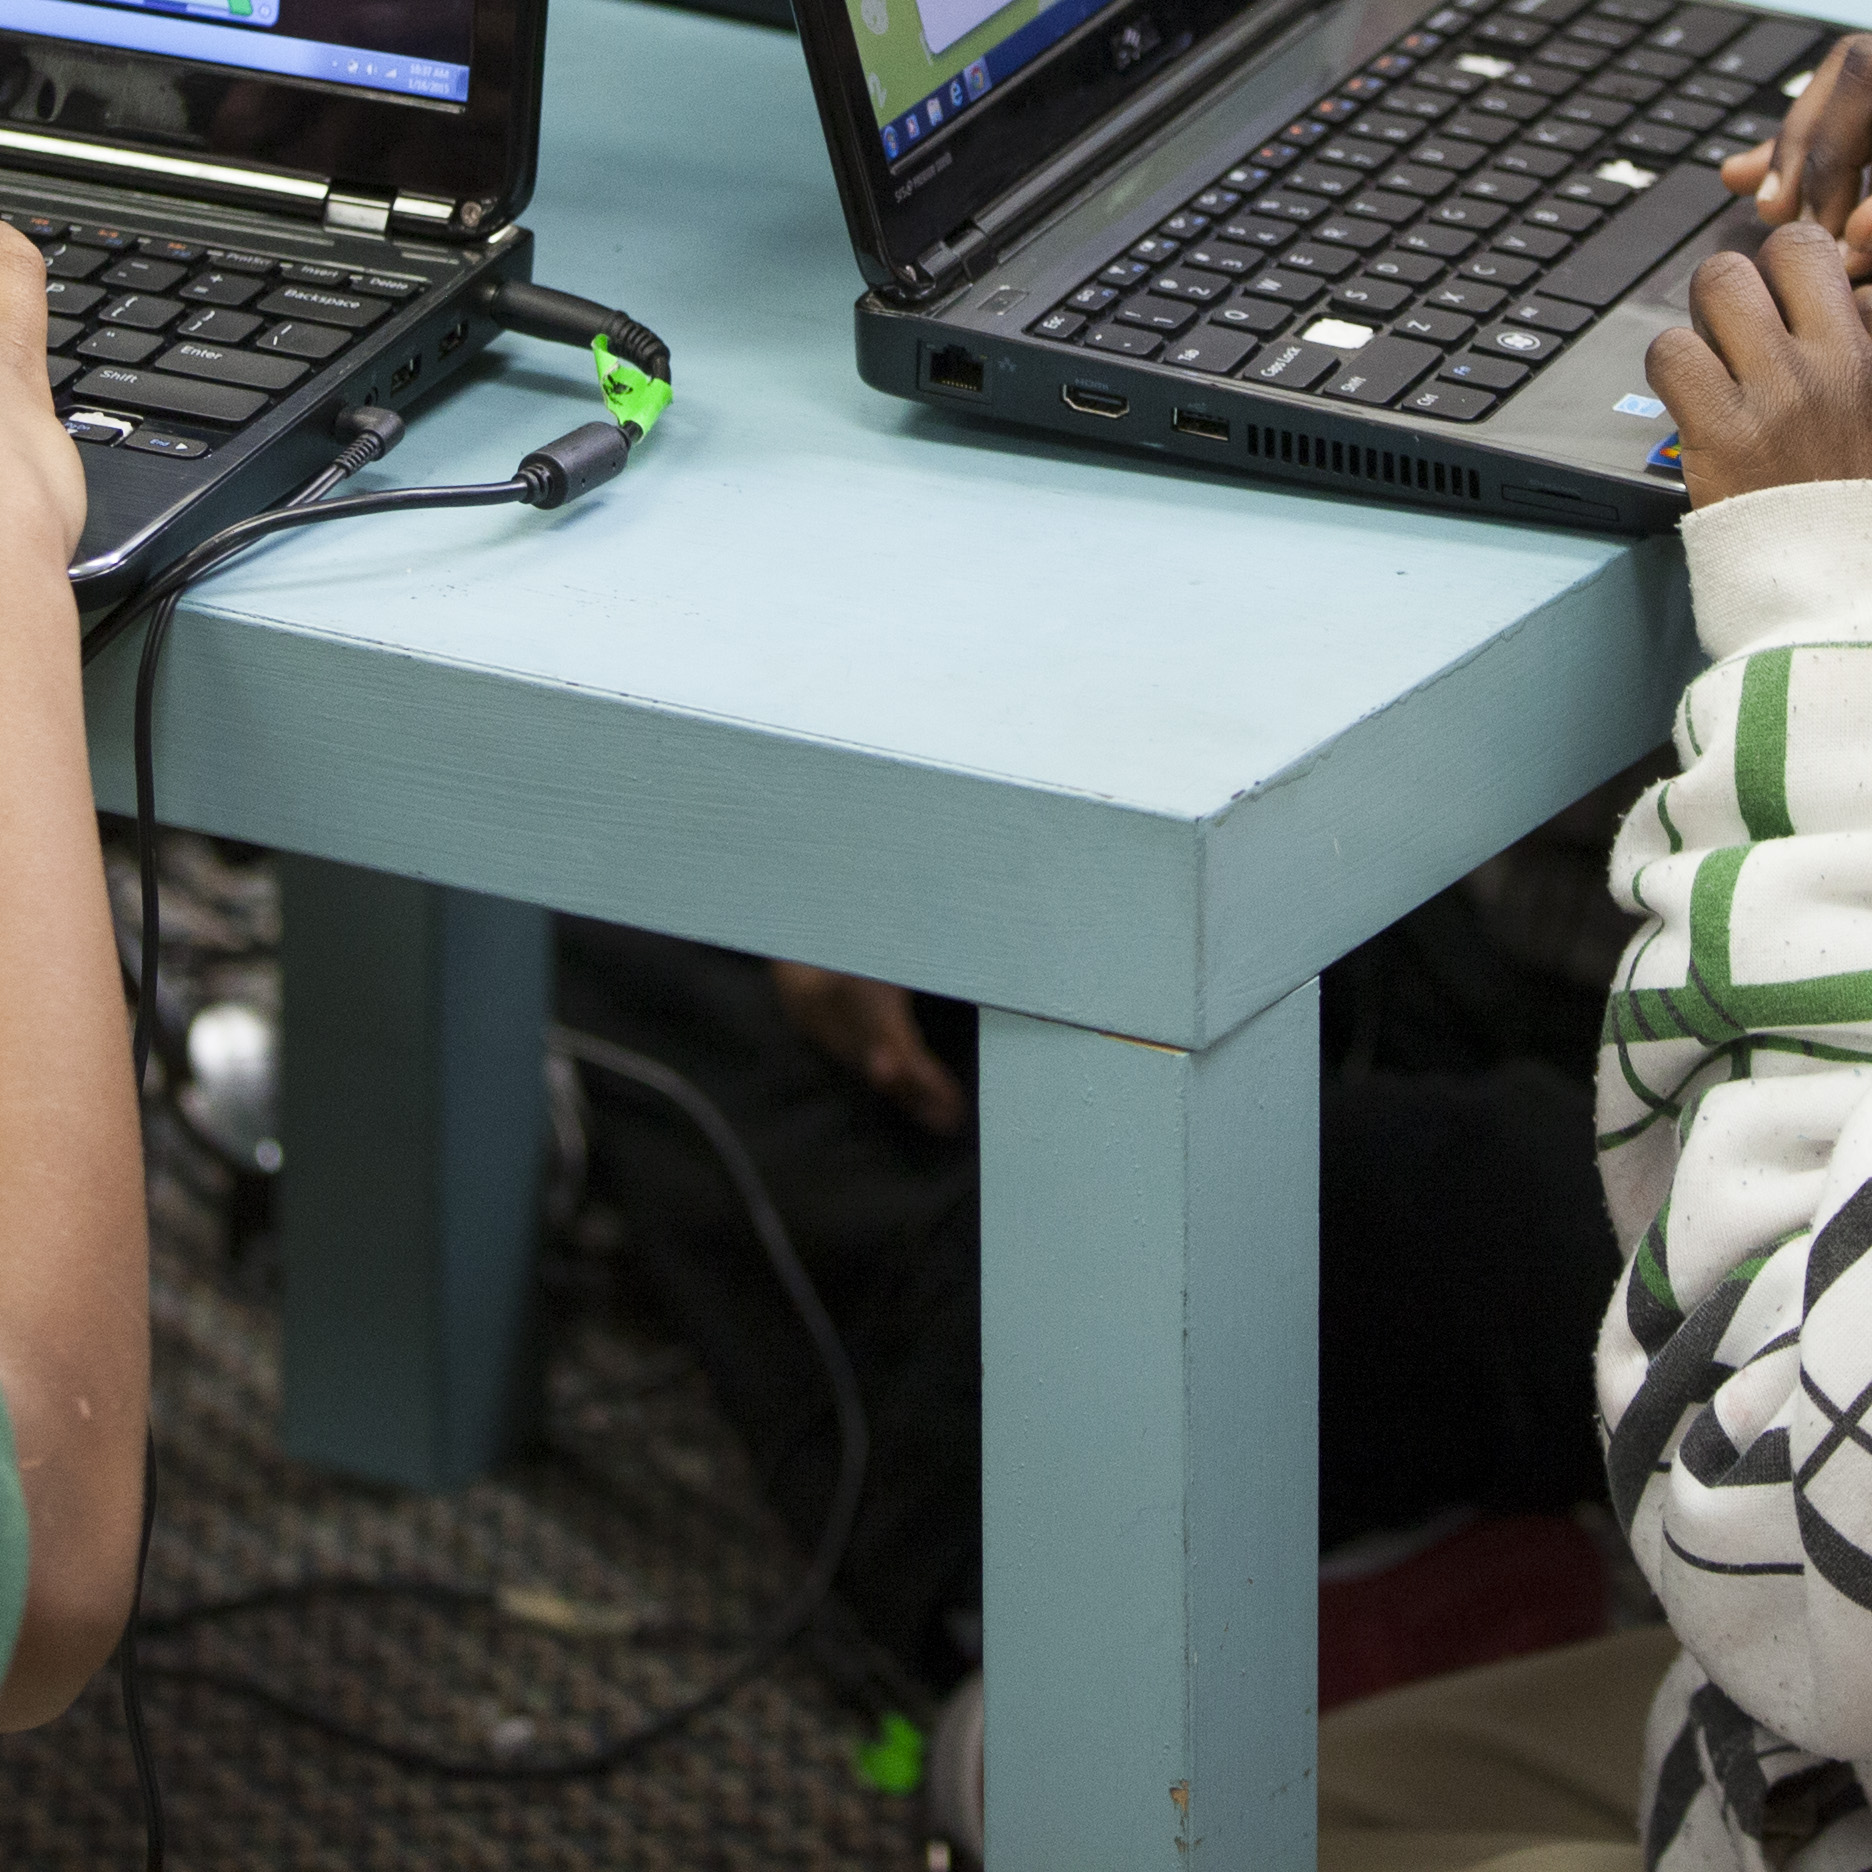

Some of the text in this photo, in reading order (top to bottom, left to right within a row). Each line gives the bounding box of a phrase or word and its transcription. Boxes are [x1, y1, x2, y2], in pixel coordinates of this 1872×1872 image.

[301, 265, 338, 278] Insert
[1473, 264, 1496, 275] C
[369, 277, 408, 290] Delete
[284, 289, 360, 309] Backspace
[1345, 290, 1368, 301] S
[1440, 290, 1465, 303] X
[1043, 316, 1065, 329] Esc
[1407, 320, 1431, 332] Z
[181, 345, 223, 361] Enter
[1178, 349, 1200, 361] Tab
[1260, 346, 1302, 377] Caps Lock
[100, 369, 137, 384] Shift
[1340, 376, 1367, 393] Shift
[1416, 393, 1439, 406] Ctrl
[149, 438, 170, 447] End
